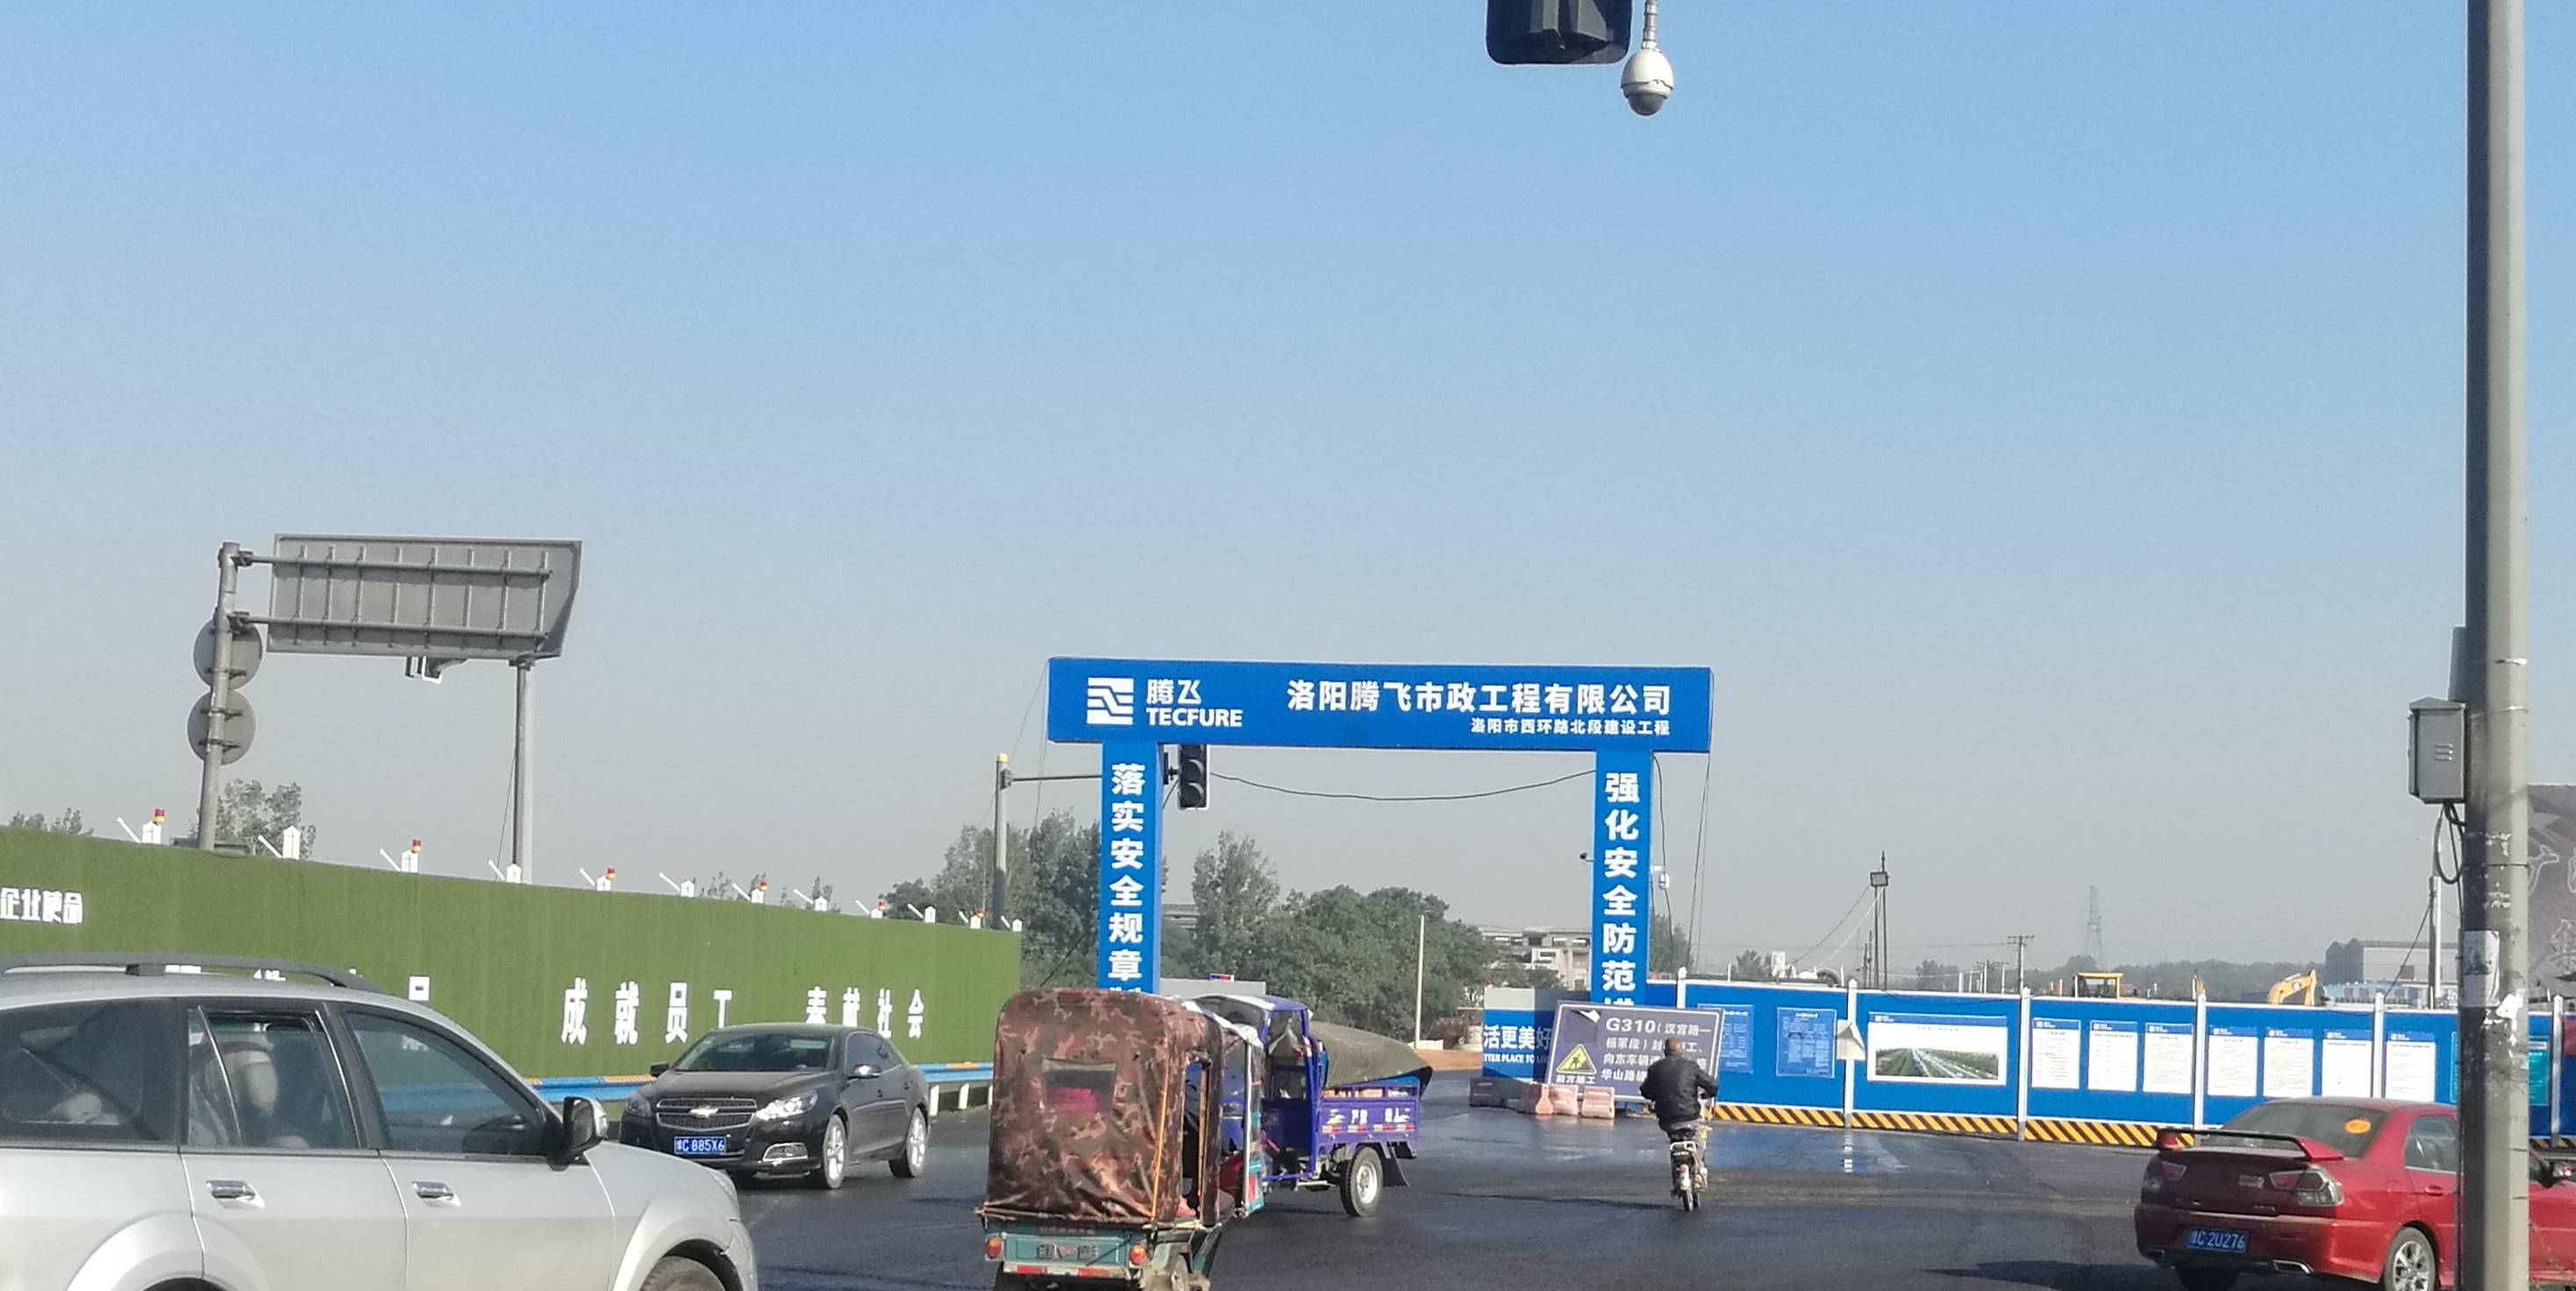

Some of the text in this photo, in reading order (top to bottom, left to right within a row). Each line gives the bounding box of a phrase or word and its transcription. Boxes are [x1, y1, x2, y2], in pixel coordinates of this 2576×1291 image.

[1146, 679, 1202, 704] 腾飞
[1287, 680, 1671, 716] 洛阳腾飞市政工程有限公司
[1145, 708, 1243, 727] TECFURE
[1471, 718, 1671, 736] 洛阳市西环路北段建设工程
[1108, 763, 1145, 992] 落实安全规章
[1602, 773, 1640, 1005] 强化安全防范
